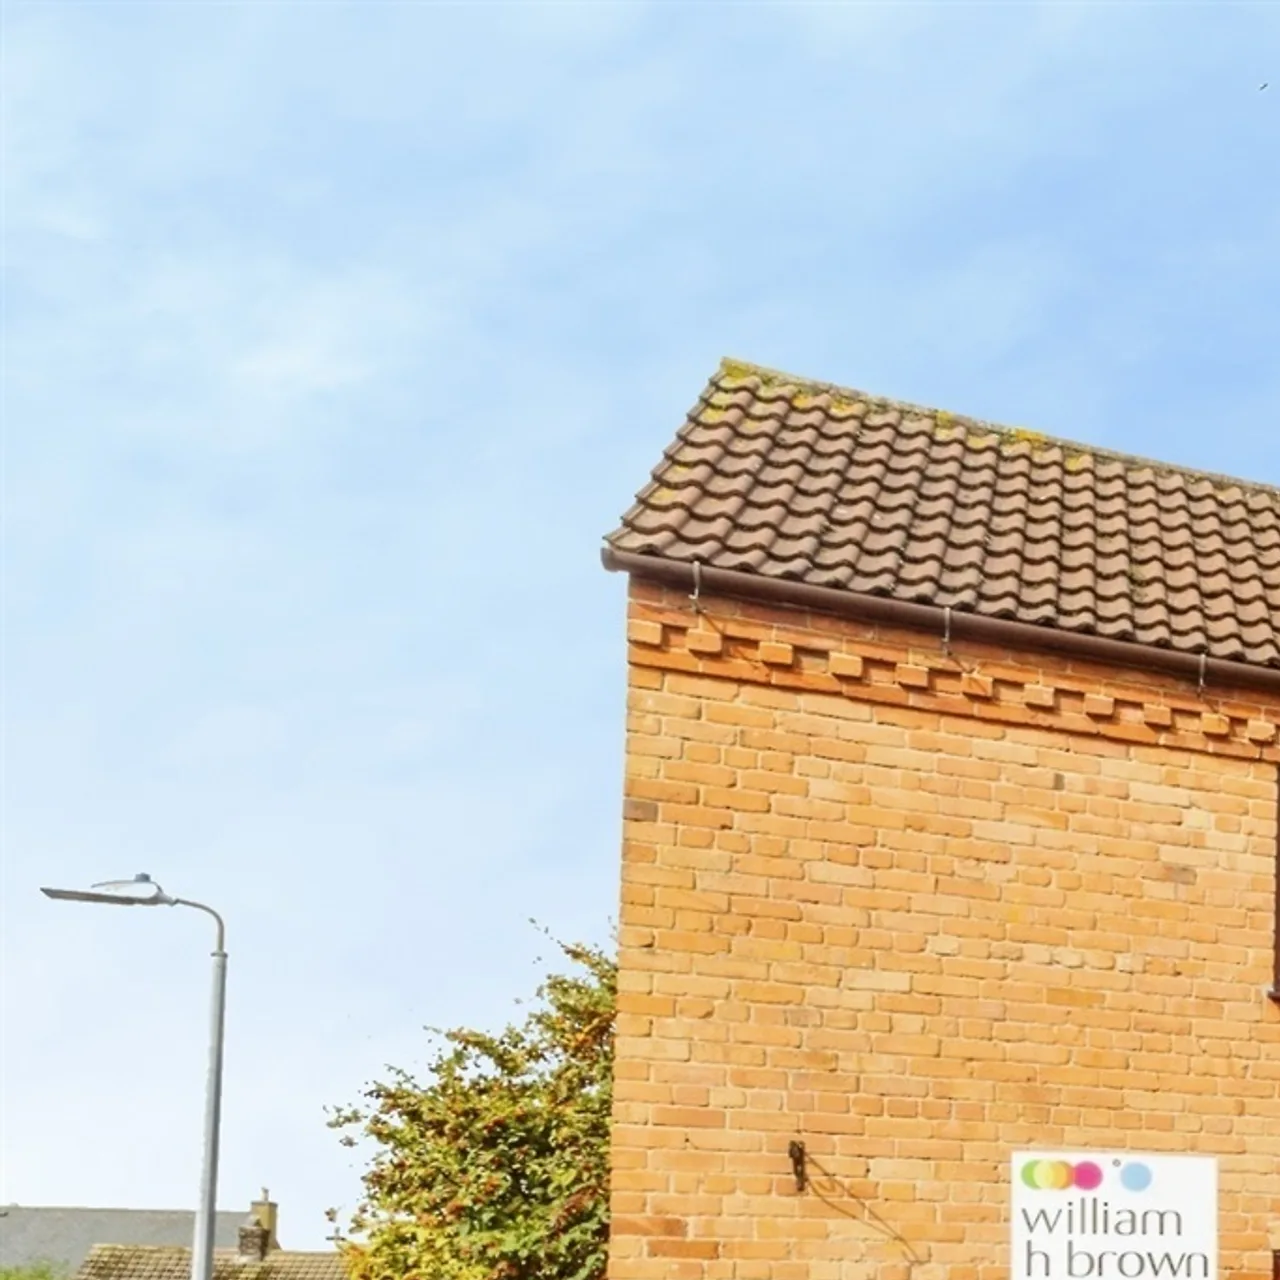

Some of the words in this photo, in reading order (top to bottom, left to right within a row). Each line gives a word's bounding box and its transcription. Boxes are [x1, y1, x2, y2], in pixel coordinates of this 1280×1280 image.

[1021, 1197, 1182, 1236] william
[1026, 1239, 1050, 1277] h
[1067, 1239, 1209, 1278] brown
